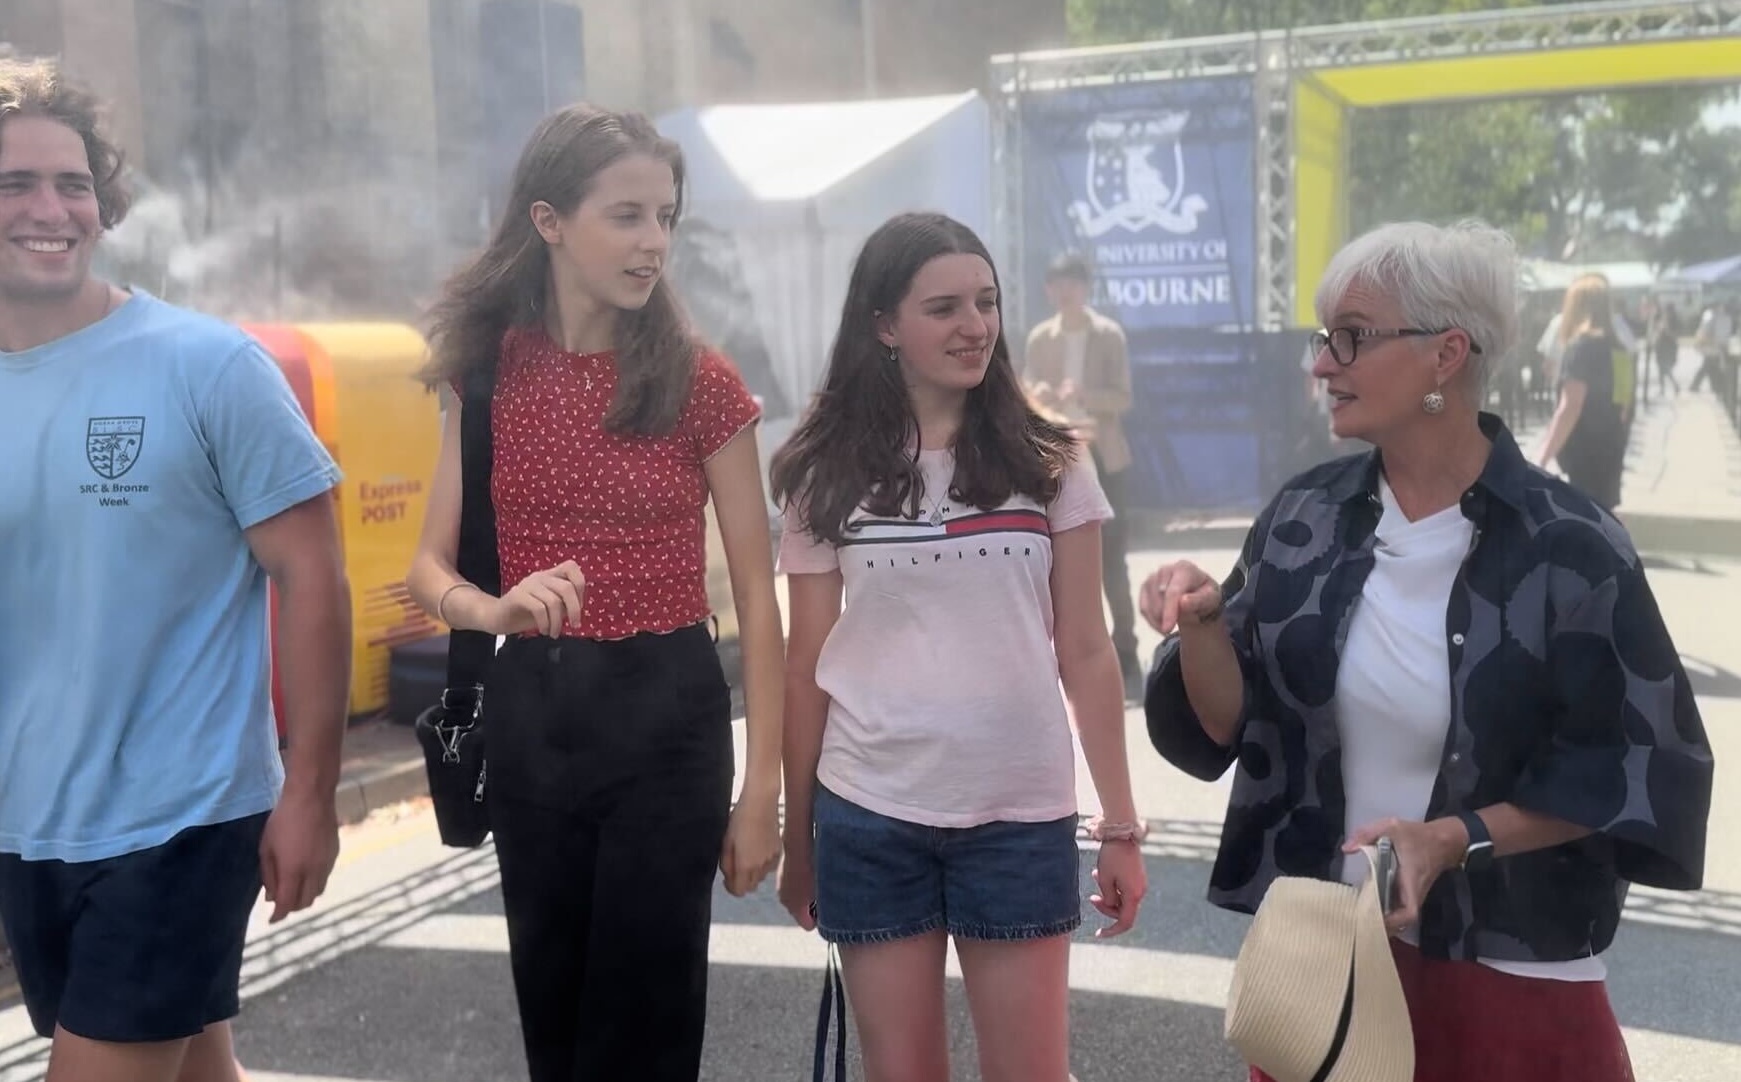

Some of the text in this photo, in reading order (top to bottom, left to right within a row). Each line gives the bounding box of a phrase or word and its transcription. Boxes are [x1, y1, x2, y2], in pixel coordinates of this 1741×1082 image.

[1106, 273, 1231, 306] BOURNE
[80, 483, 149, 494] SRC & Bronze
[360, 480, 422, 501] Express
[99, 497, 129, 507] Week
[361, 501, 407, 525] POST
[866, 547, 1031, 569] HILFIGER
